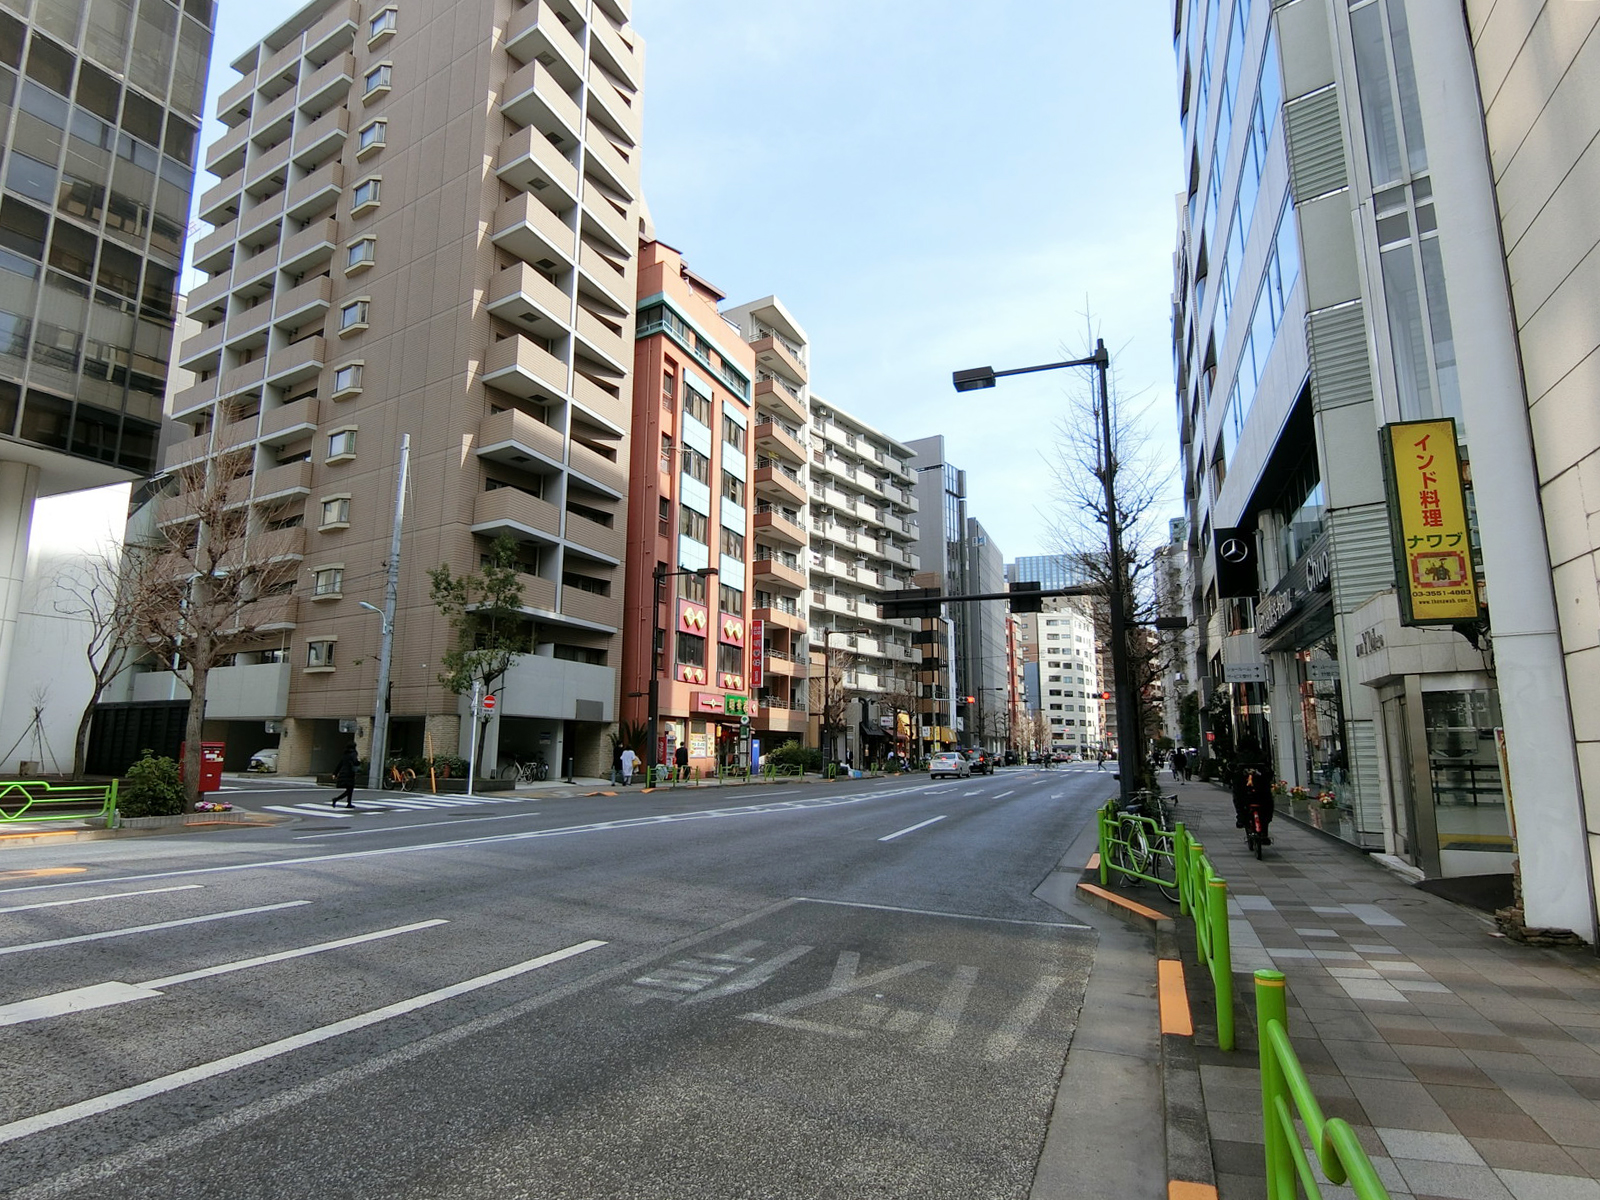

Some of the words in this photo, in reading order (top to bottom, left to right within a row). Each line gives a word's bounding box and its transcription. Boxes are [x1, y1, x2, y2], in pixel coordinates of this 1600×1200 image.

[1414, 434, 1443, 527] インド料理
[1407, 531, 1463, 549] ナワブ
[1306, 551, 1329, 592] Chuo
